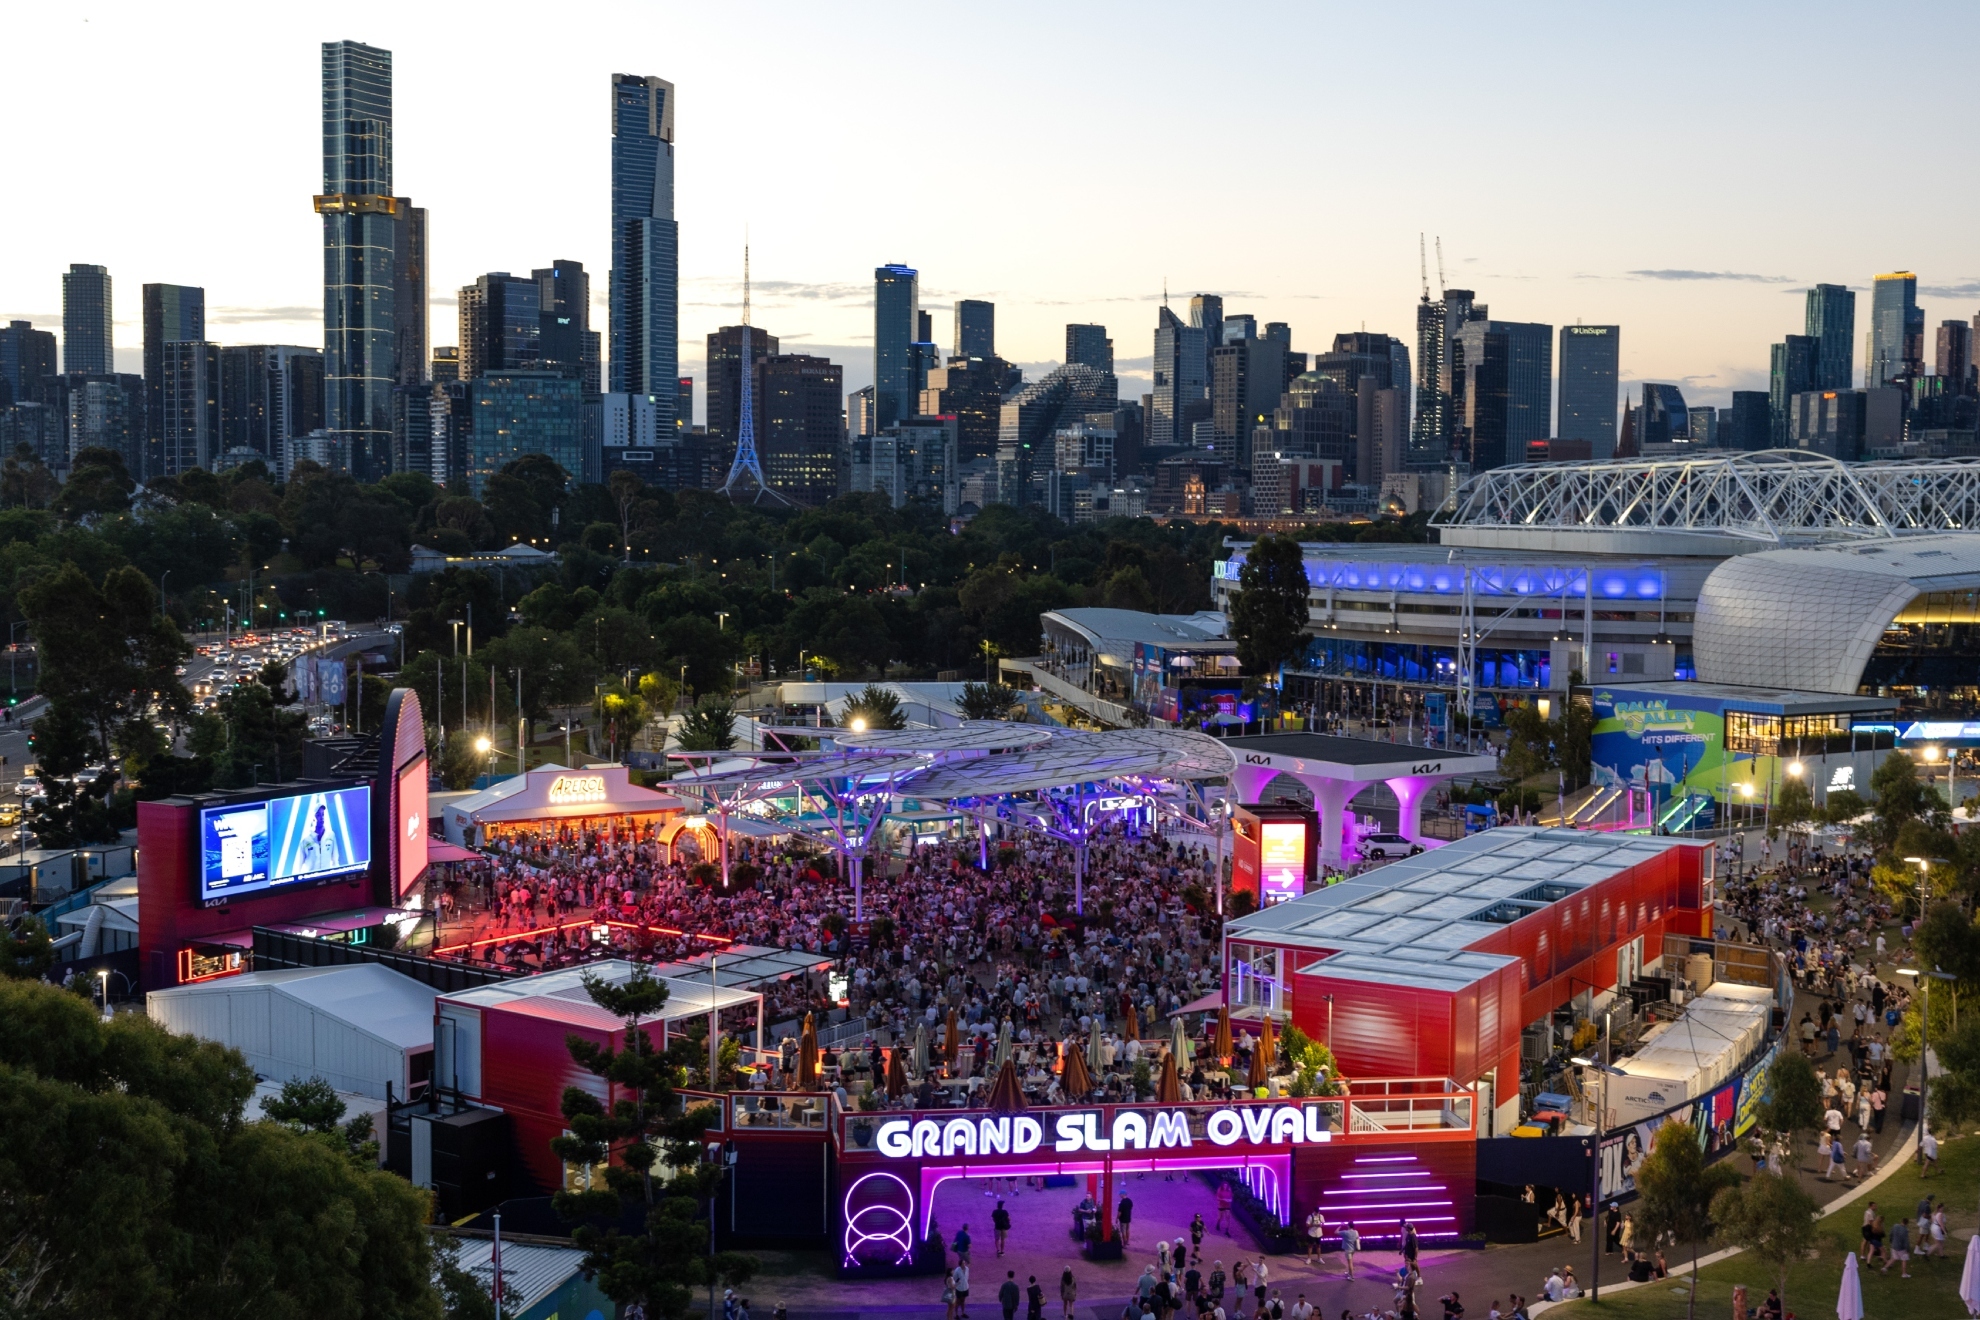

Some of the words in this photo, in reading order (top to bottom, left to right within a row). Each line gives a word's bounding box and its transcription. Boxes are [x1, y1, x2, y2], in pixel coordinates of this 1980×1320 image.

[1579, 327, 1607, 336] UniSuper
[1615, 700, 1668, 714] RALLY
[1644, 710, 1697, 724] ALLEY
[1641, 736, 1662, 745] HITS
[1664, 733, 1716, 744] DIFFERENT
[551, 777, 604, 795] APEROL
[876, 1116, 1042, 1158] GRAND
[1055, 1111, 1192, 1152] SLAM
[1207, 1106, 1331, 1146] OVAL
